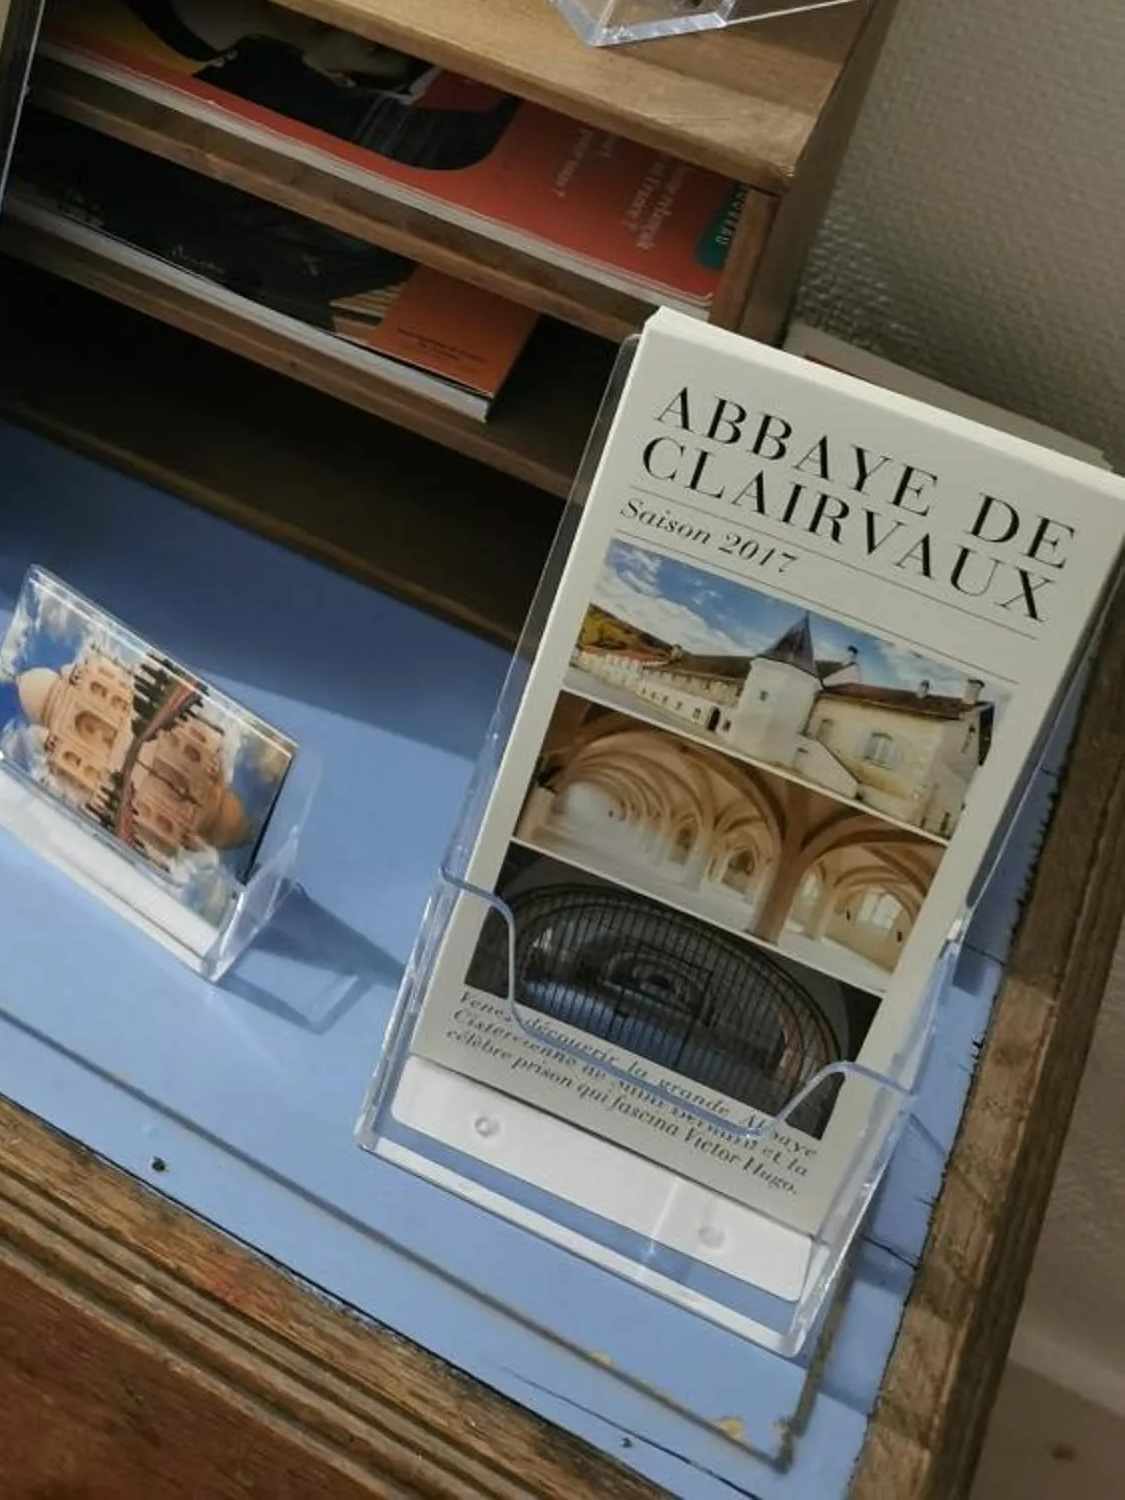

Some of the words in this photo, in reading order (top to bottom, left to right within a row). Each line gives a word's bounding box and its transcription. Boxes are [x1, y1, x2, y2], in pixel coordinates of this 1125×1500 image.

[620, 499, 713, 546] Saison
[719, 533, 799, 575] 2017
[643, 434, 1055, 622] CLAIRVAUX
[654, 387, 939, 517] ABBAYE
[966, 492, 1076, 569] DE
[446, 1029, 513, 1060] célèbre
[510, 1056, 573, 1089] prison
[577, 1083, 613, 1104] qui
[608, 1095, 680, 1136] fascina
[685, 1127, 742, 1165] Victor
[742, 1155, 797, 1195] Hugo.
[763, 1144, 781, 1163] et
[787, 1157, 808, 1177] la
